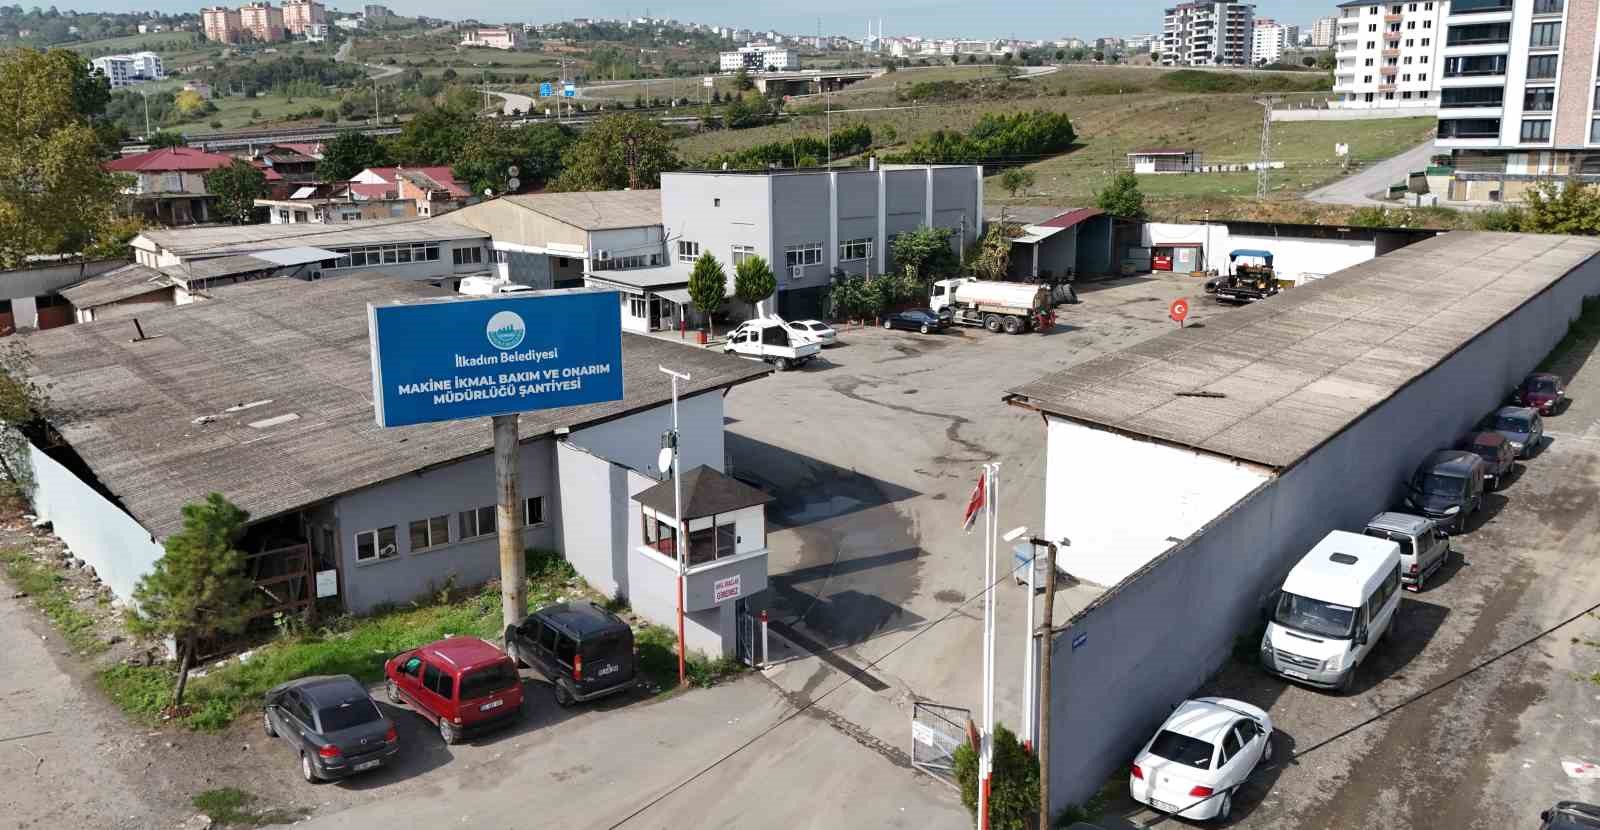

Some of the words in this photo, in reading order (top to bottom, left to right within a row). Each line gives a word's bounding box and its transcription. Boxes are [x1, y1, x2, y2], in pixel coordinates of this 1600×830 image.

[455, 353, 498, 368] İlkadım
[500, 347, 558, 363] Belediyesi
[398, 378, 452, 395] MAKİNE
[455, 375, 496, 389] İKMAL
[499, 370, 540, 384] BAKIM
[543, 369, 560, 380] VE
[562, 363, 610, 378] ONARIM
[433, 383, 516, 405] MÜDÜRLÜĞÜ
[519, 376, 581, 398] ŞANTİYESİ
